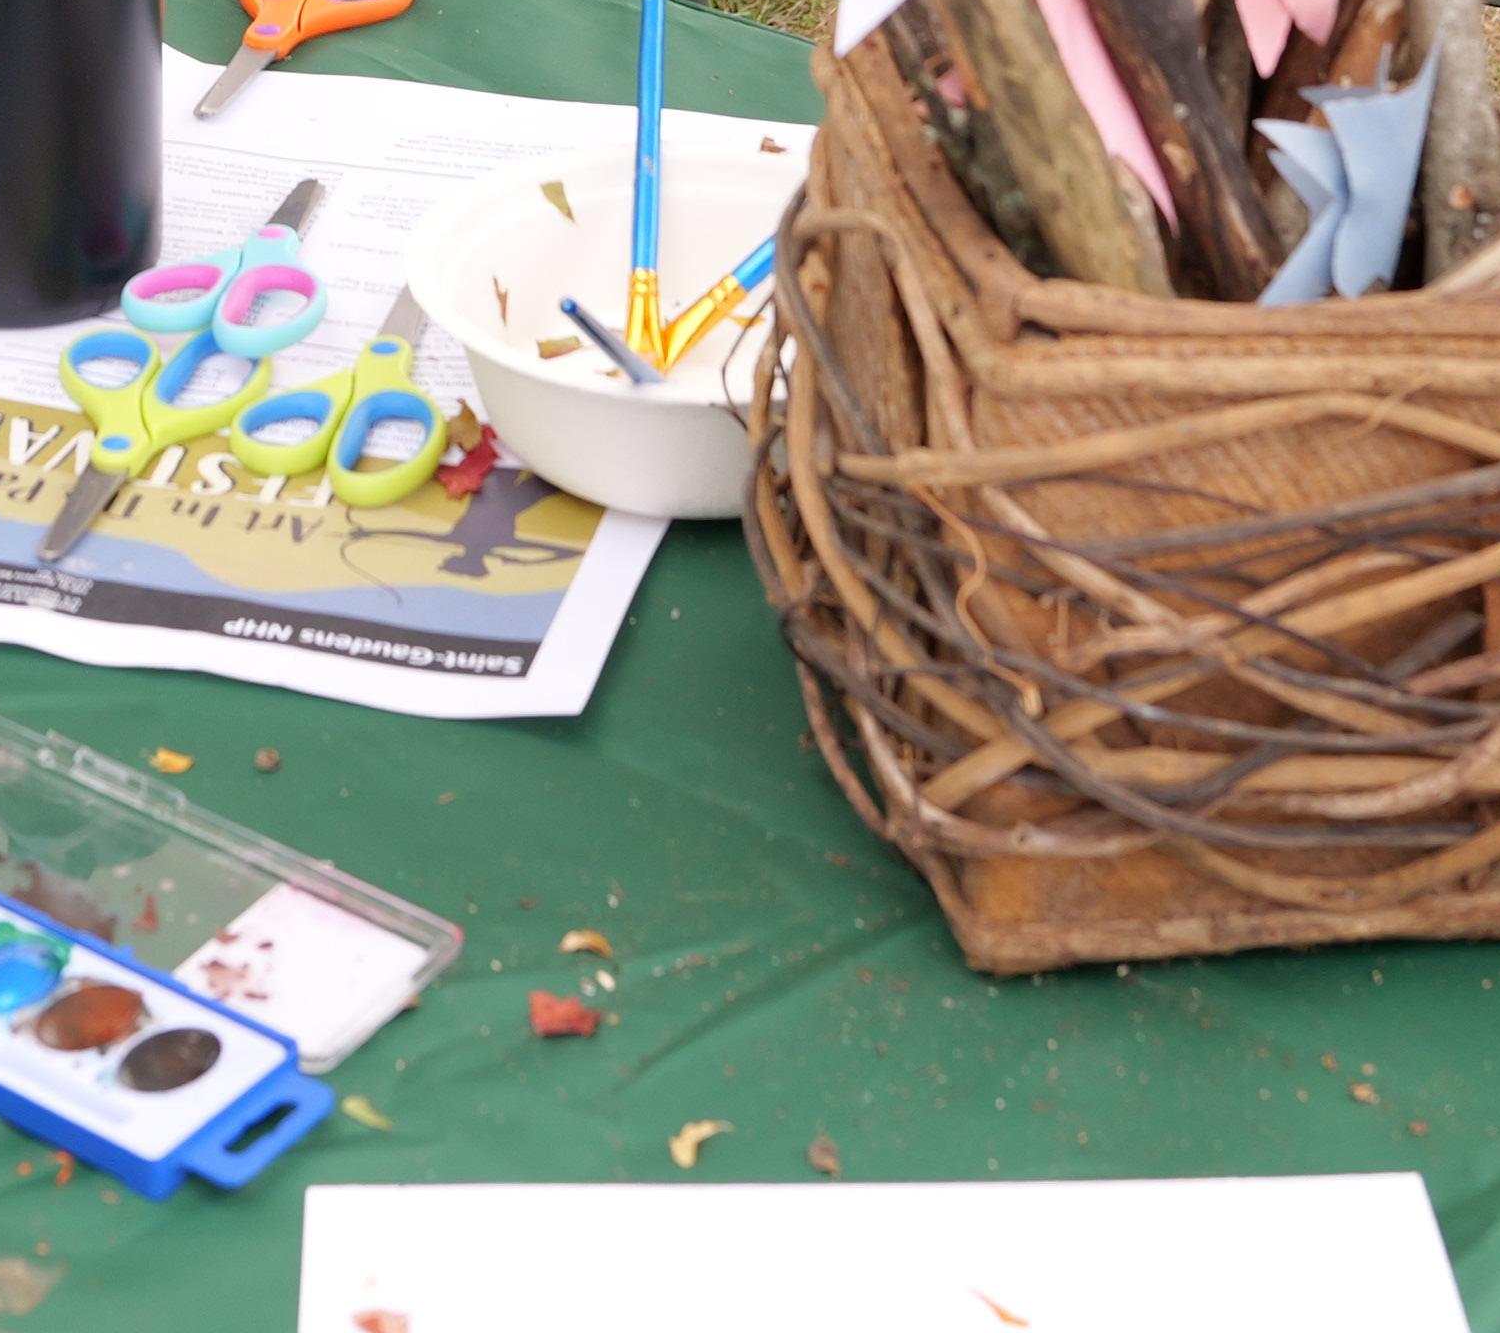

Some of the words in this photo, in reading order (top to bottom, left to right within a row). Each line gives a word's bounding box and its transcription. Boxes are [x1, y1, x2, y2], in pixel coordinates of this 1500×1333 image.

[171, 499, 221, 528] In
[245, 509, 324, 544] Art
[222, 617, 294, 643] NHP
[299, 626, 525, 676] Saint-Gaudens
